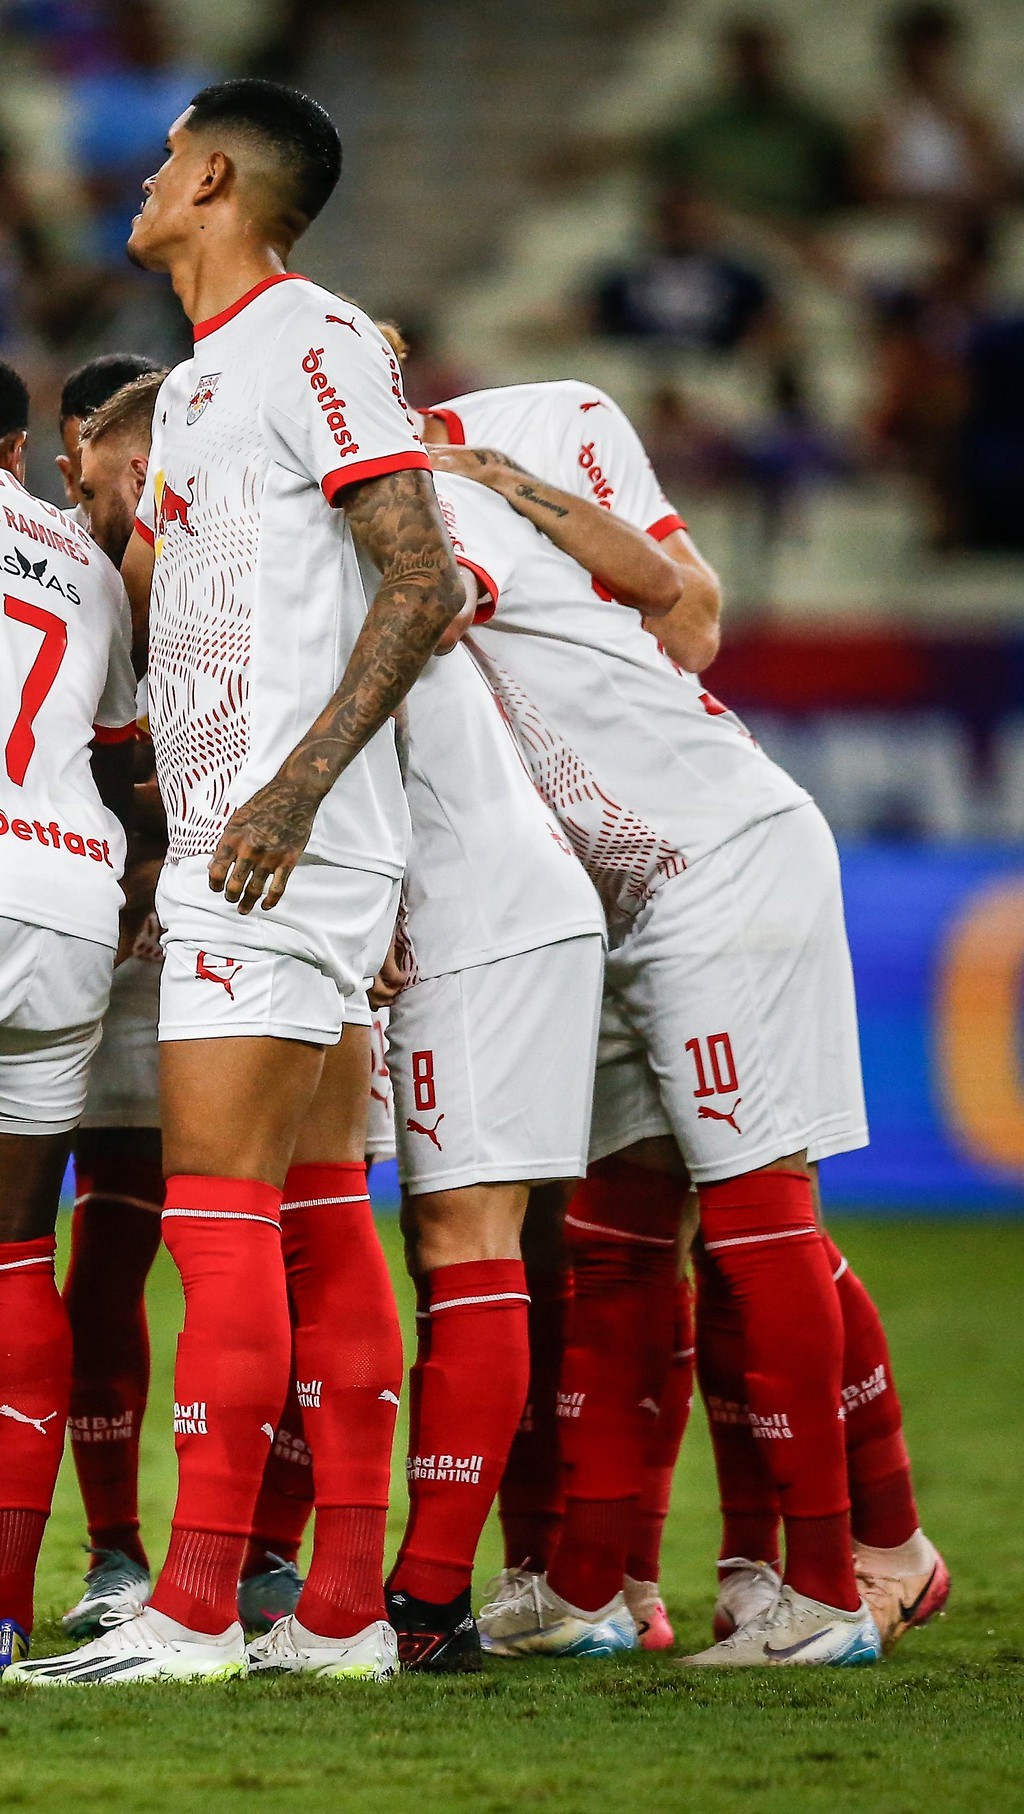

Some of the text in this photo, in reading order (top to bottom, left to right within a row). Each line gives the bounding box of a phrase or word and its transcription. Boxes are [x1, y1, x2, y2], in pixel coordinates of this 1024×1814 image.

[302, 347, 359, 458] betfast
[2, 505, 90, 566] RAMIRES
[3, 593, 68, 787] 7
[412, 1050, 436, 1111] 8
[684, 1032, 739, 1098] 10
[438, 1455, 483, 1471] Bull
